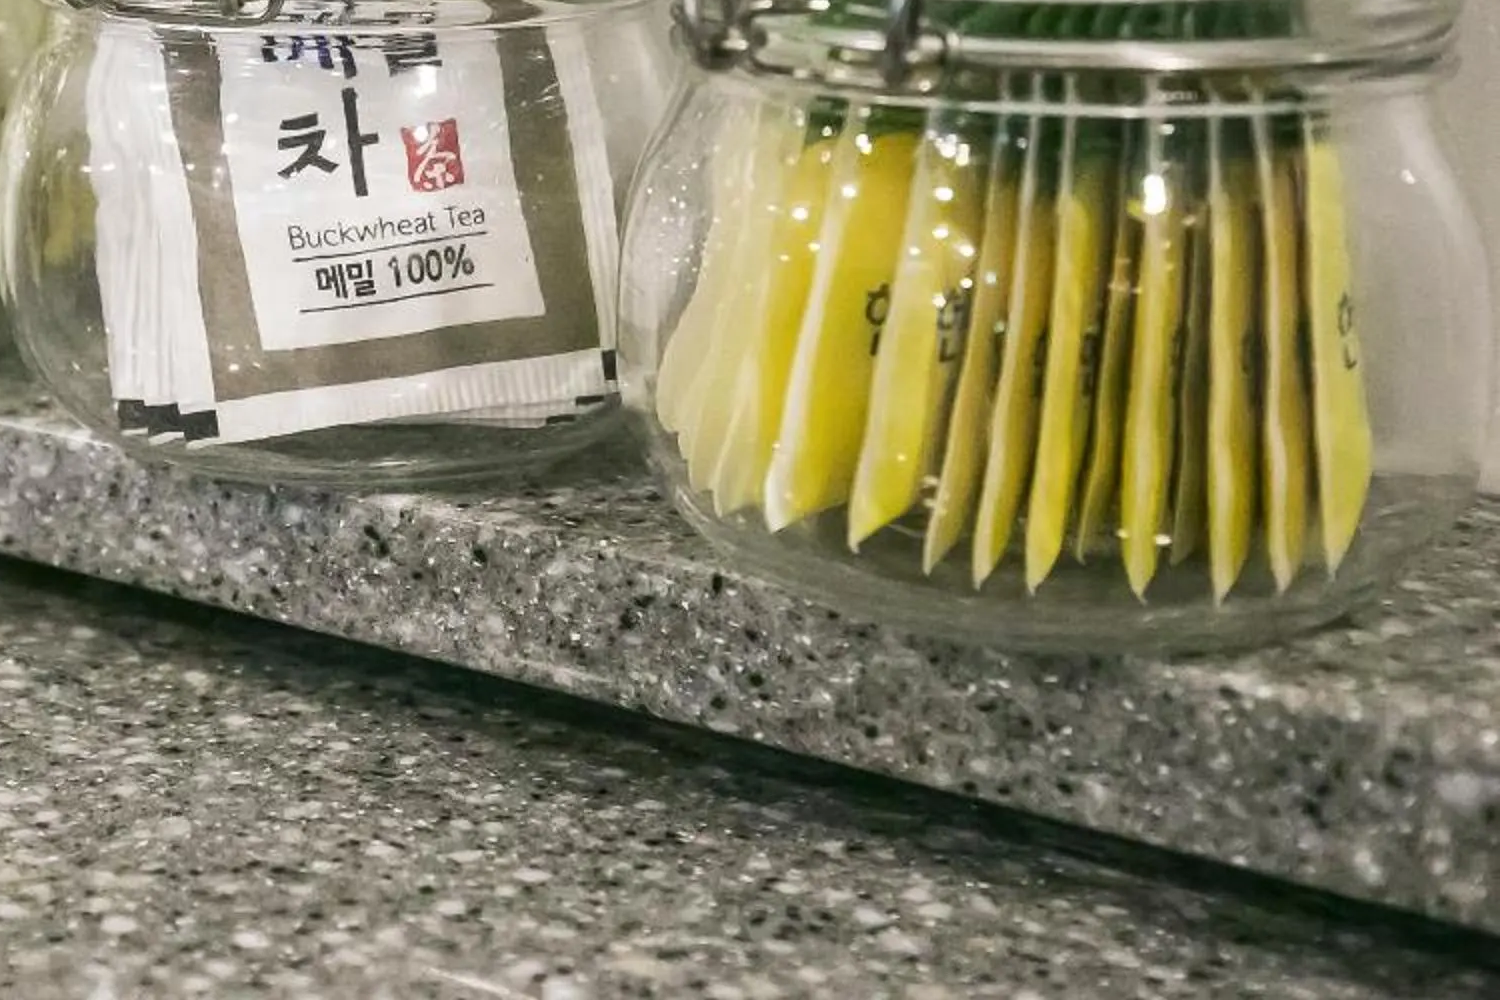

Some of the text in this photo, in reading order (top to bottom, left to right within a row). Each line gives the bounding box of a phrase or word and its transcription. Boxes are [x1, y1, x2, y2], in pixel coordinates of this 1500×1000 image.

[277, 87, 379, 197] 차
[288, 205, 486, 251] Buckwheat Tea
[315, 244, 475, 299] 메밀 100%
